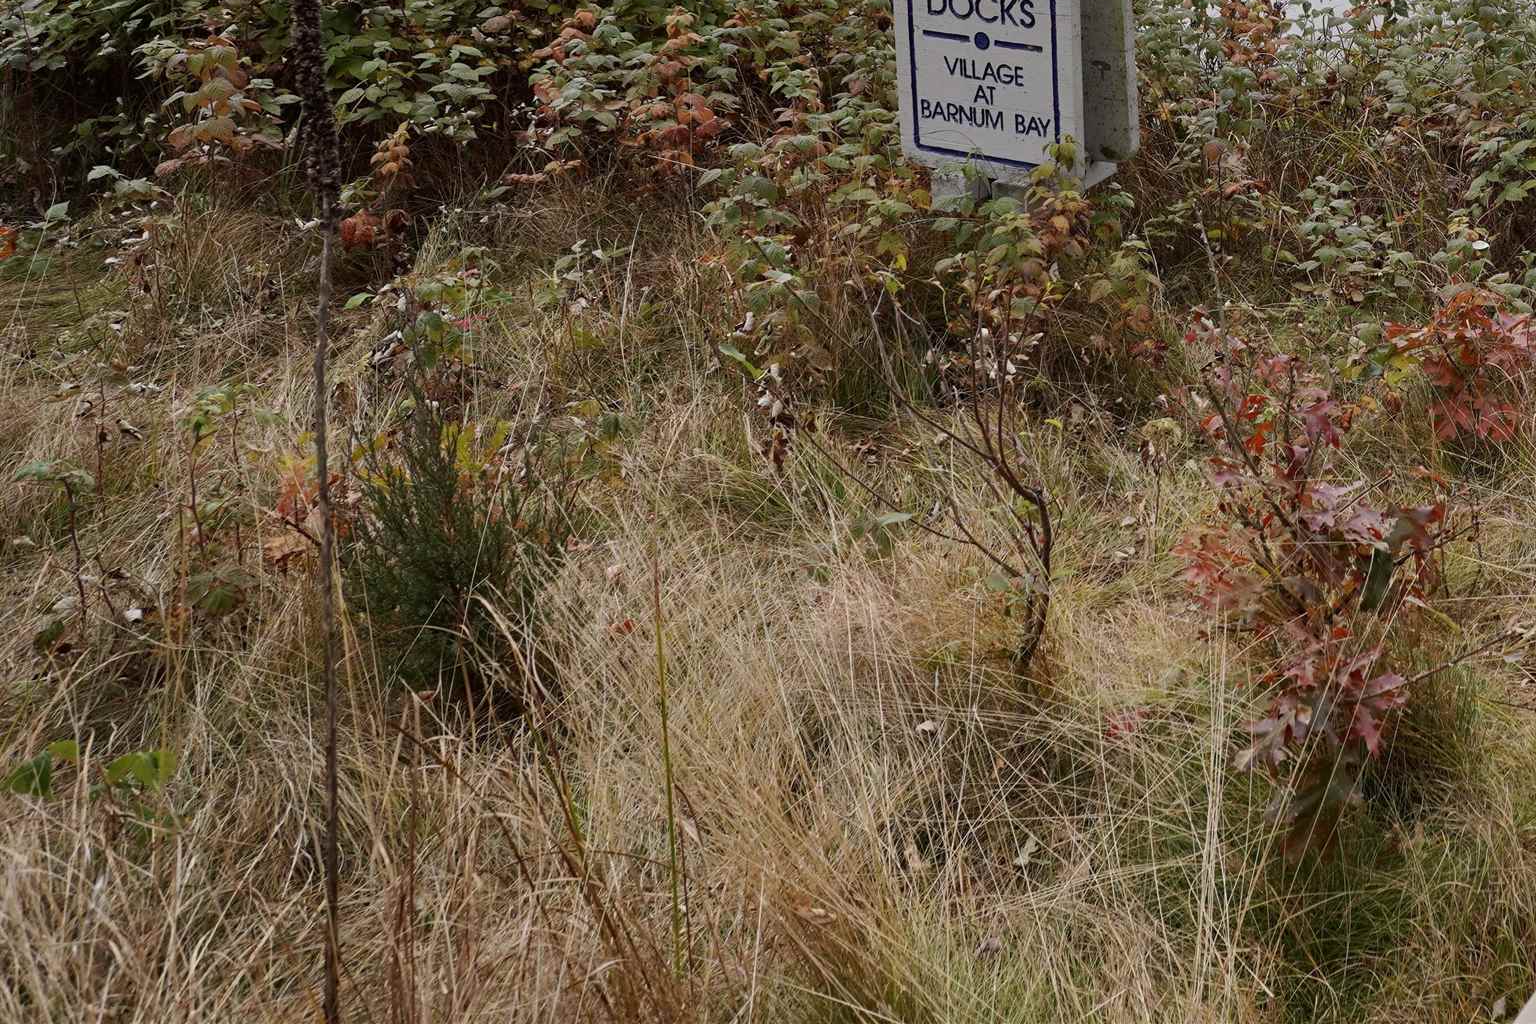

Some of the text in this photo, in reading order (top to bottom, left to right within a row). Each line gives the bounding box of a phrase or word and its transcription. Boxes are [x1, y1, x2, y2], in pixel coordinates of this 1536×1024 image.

[944, 56, 1025, 87] VILLAGE
[973, 85, 996, 105] AT
[920, 99, 1051, 138] BARNUM BAY
